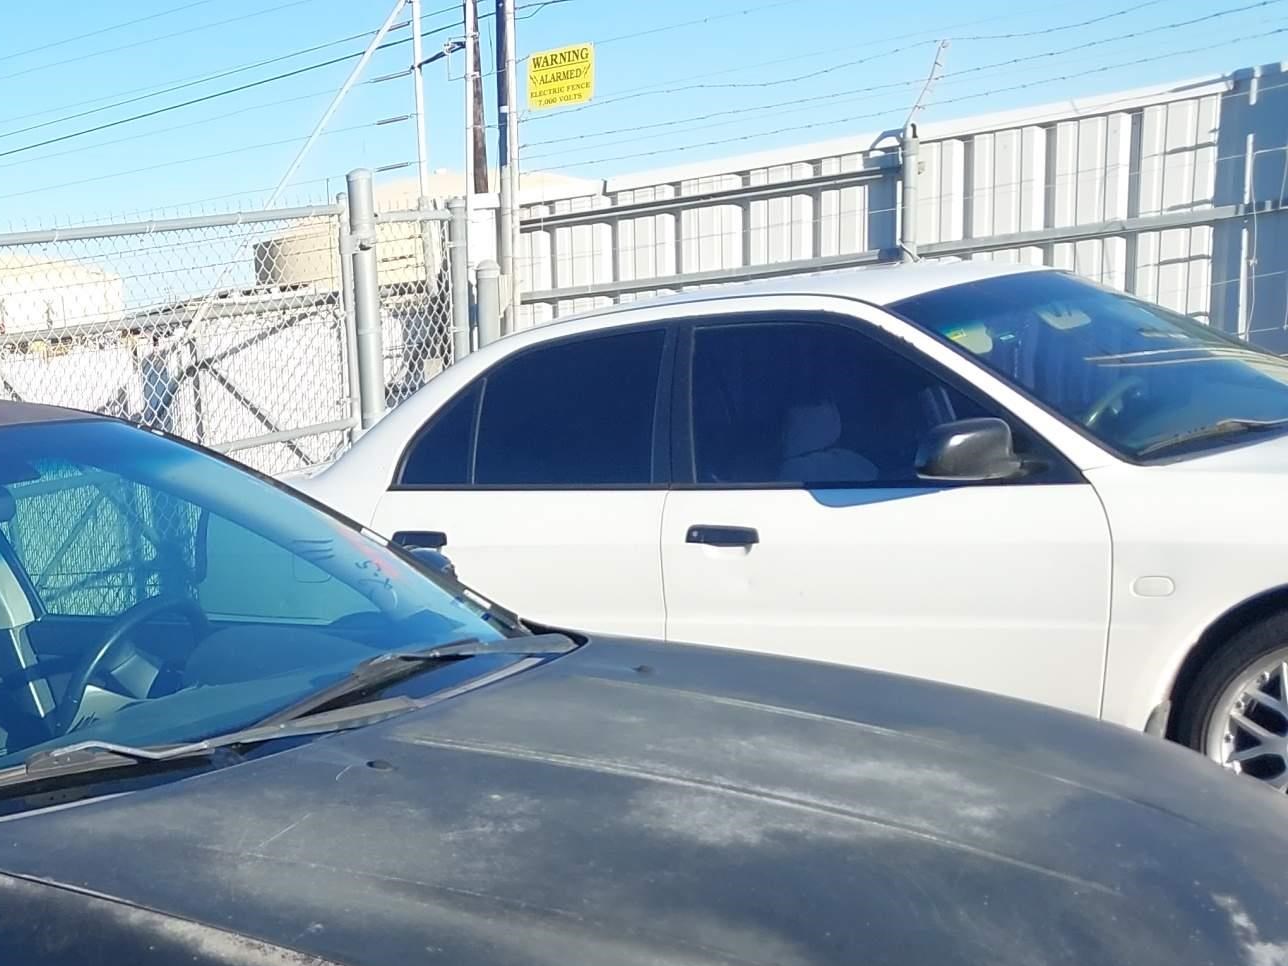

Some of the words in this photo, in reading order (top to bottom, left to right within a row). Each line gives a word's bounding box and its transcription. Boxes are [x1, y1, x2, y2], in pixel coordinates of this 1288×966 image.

[532, 48, 589, 68] WARNING
[539, 68, 582, 85] ALARMED
[531, 87, 564, 98] ELECTRIC
[566, 82, 590, 91] FENCE
